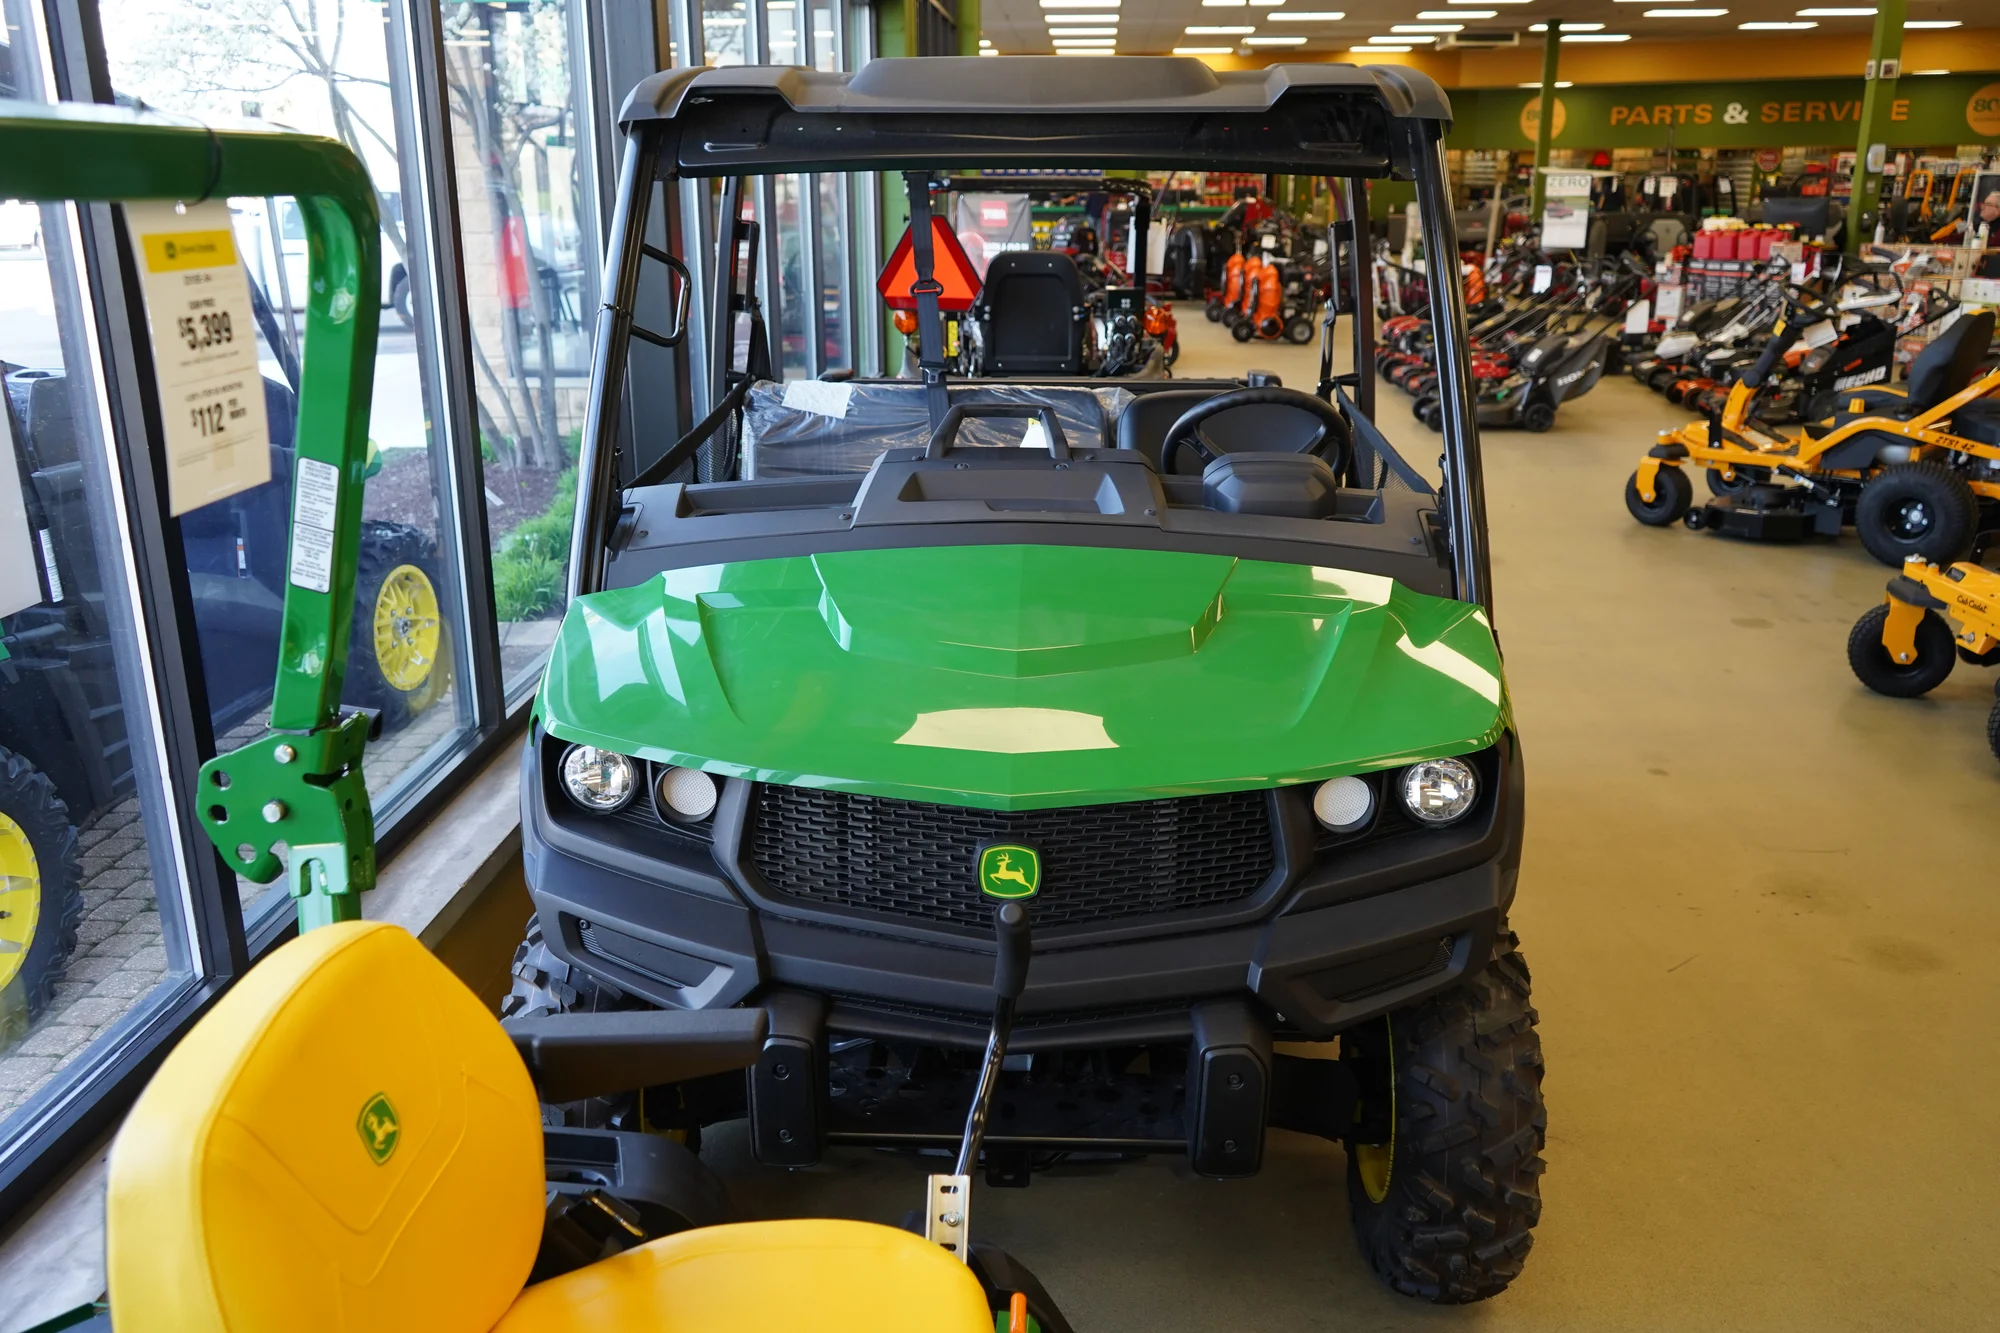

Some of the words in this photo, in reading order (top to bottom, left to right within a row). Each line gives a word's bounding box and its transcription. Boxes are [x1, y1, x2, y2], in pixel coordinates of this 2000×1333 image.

[1610, 104, 1713, 126] PARTS
[1723, 102, 1749, 125] &
[1760, 99, 1910, 123] SERVIE
[1549, 175, 1589, 188] ZERO
[178, 311, 232, 351] $5,399
[1556, 361, 1600, 387] HONA
[191, 402, 225, 437] $112
